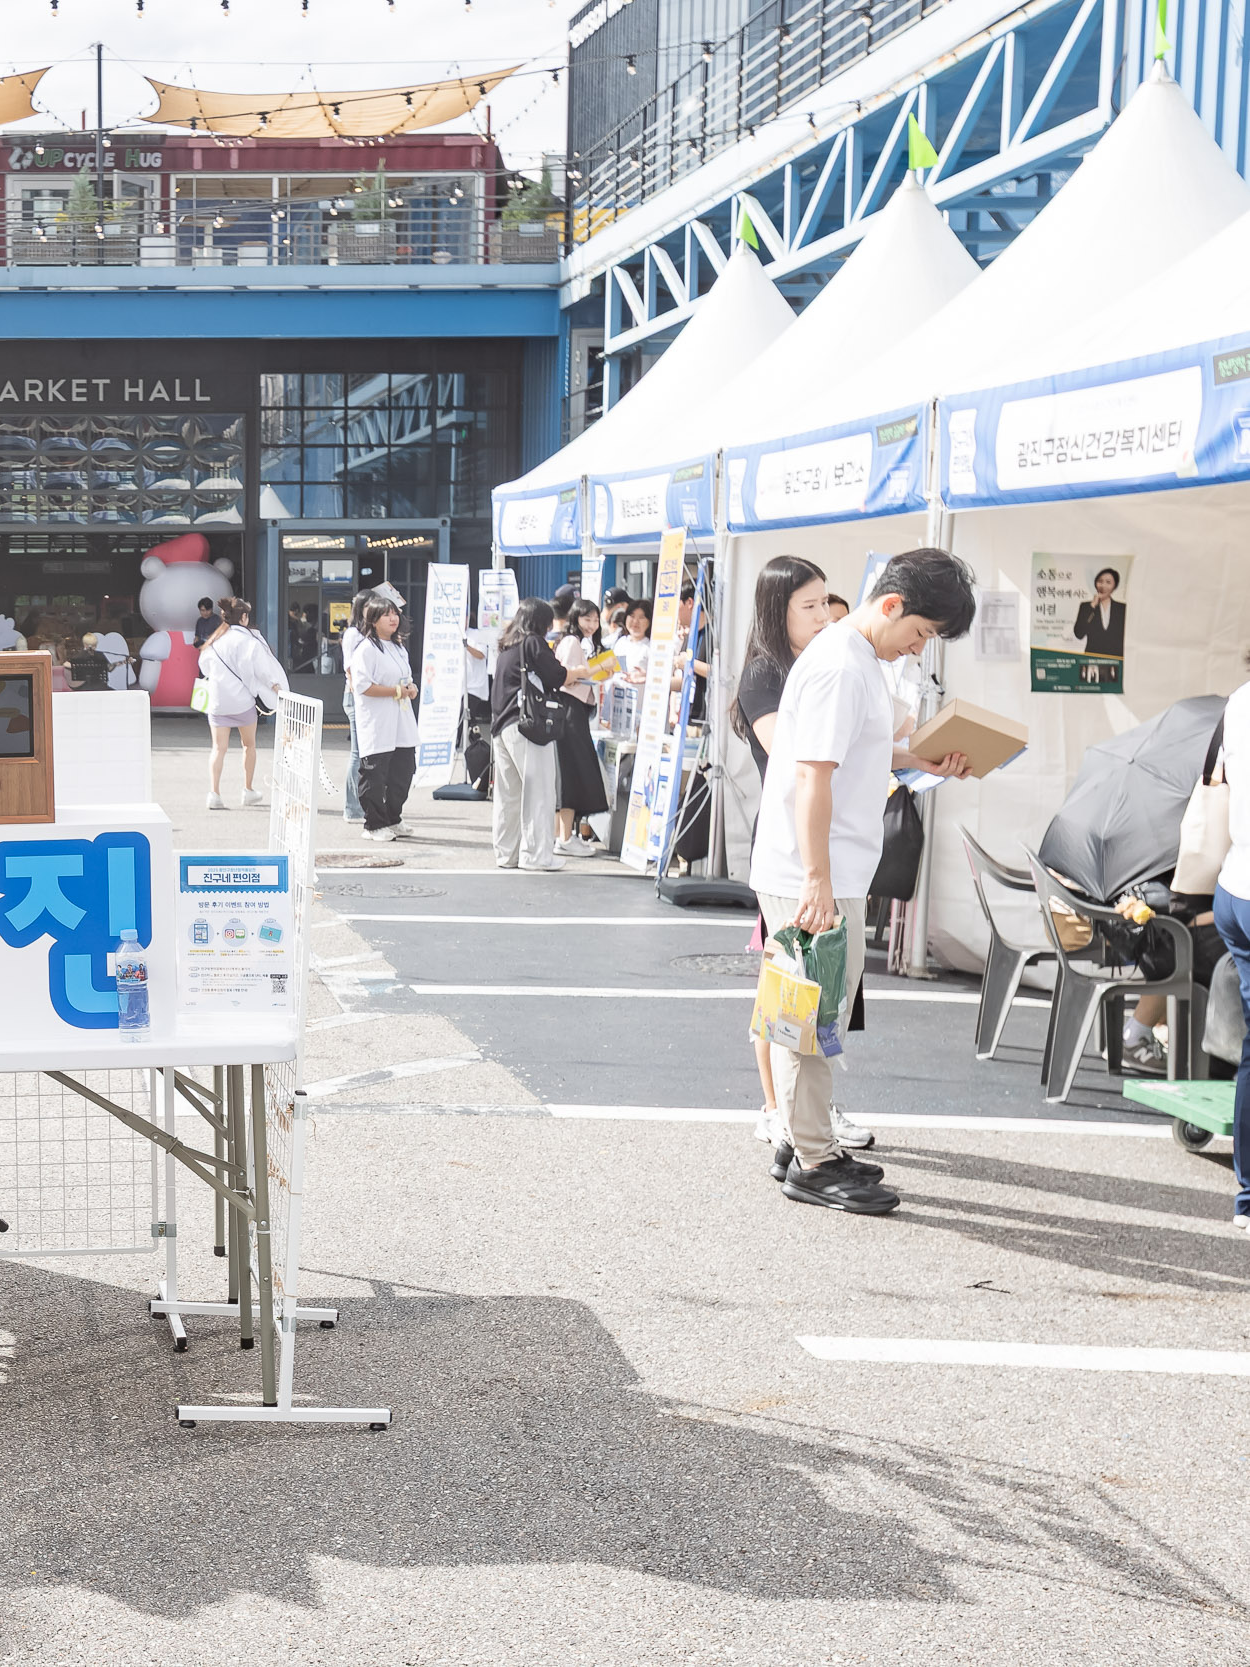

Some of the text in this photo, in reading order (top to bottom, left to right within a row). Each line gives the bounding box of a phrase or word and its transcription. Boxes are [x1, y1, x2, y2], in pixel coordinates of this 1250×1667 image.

[125, 148, 162, 168] HUG
[124, 379, 211, 402] HALL
[1017, 420, 1182, 468] 광진구정신건강복지센터
[203, 873, 260, 883] 진구네 편의점
